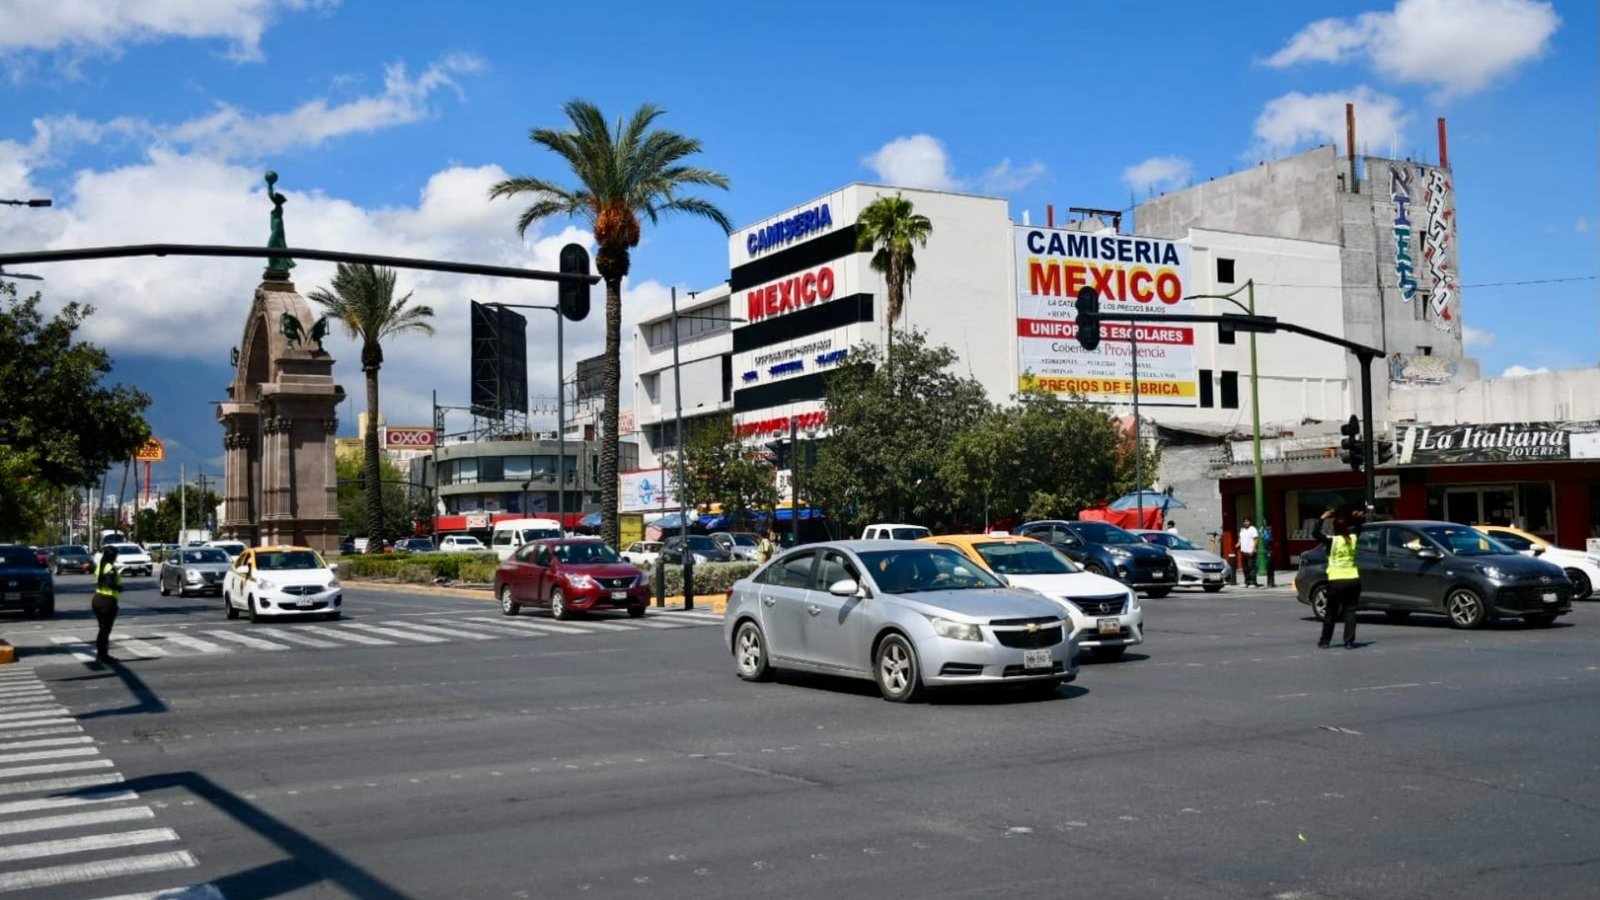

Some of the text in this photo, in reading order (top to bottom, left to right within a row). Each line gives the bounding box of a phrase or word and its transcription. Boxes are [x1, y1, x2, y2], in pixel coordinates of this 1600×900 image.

[747, 203, 833, 256] CAMISERIA
[1027, 230, 1180, 266] CAMISERIA
[1027, 257, 1182, 305] MEXICO
[747, 267, 835, 323] MEXICO
[1030, 322, 1108, 338] UNIFORS
[1104, 343, 1166, 357] Proviencia
[1103, 381, 1120, 393] DE
[1125, 382, 1180, 395] FBRICA
[390, 432, 431, 445] OXXO
[1419, 428, 1452, 450] La
[1461, 425, 1565, 450] Italiana
